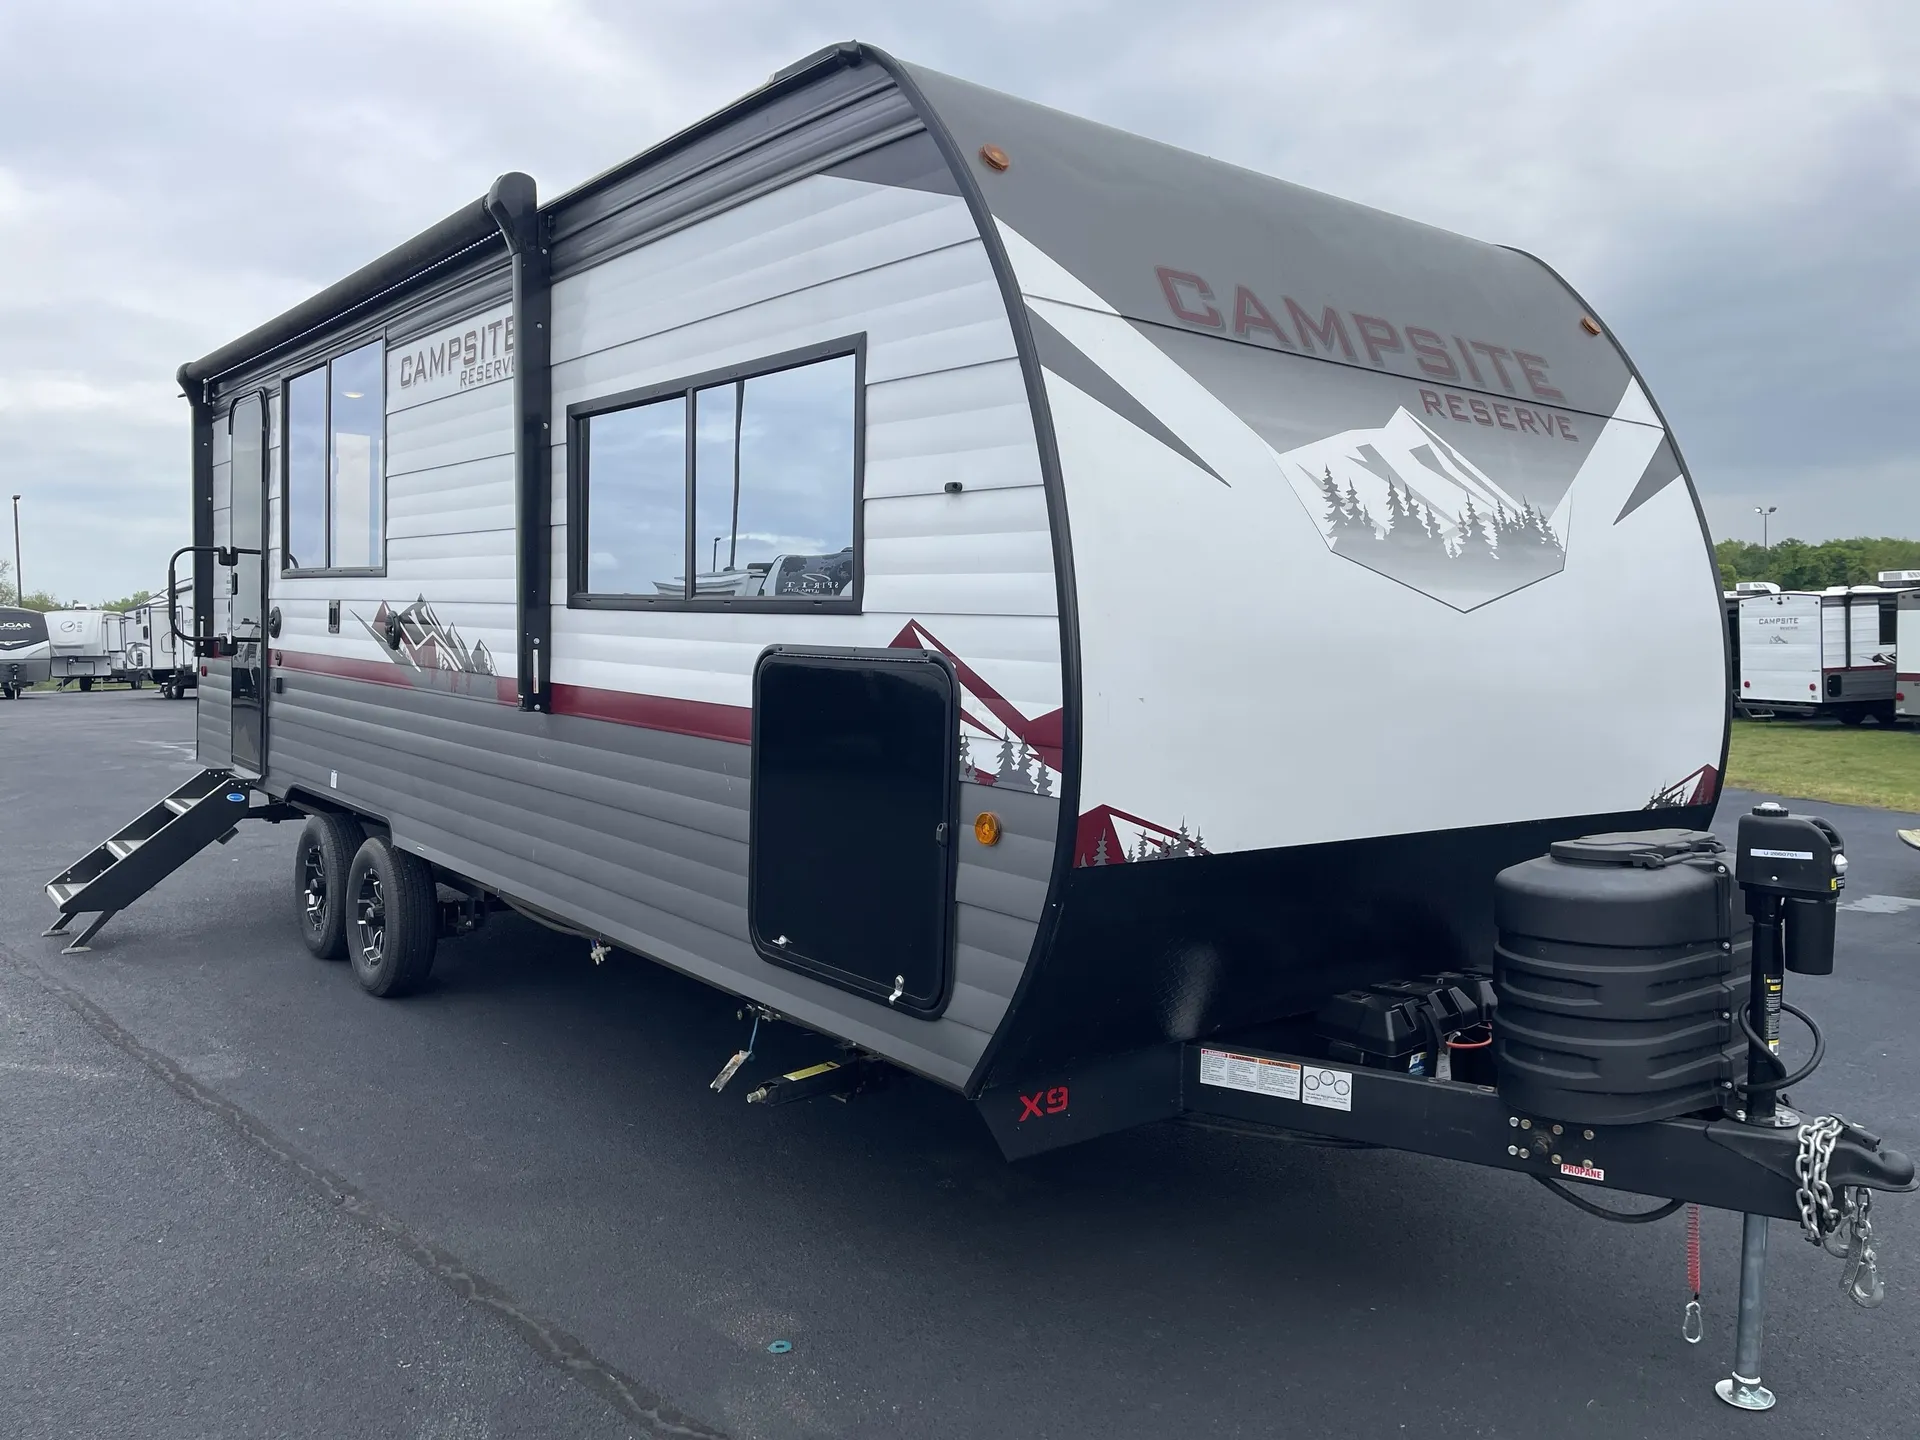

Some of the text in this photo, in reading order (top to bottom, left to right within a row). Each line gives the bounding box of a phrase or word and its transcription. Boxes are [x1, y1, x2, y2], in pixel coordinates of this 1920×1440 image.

[400, 315, 513, 387] CAMPSITE
[1154, 264, 1566, 400] CAMPSITE
[1418, 388, 1579, 442] RESERVE
[1758, 617, 1799, 625] CAMPSITE
[1018, 1086, 1069, 1122] X9
[1562, 1165, 1603, 1179] PROPANE
